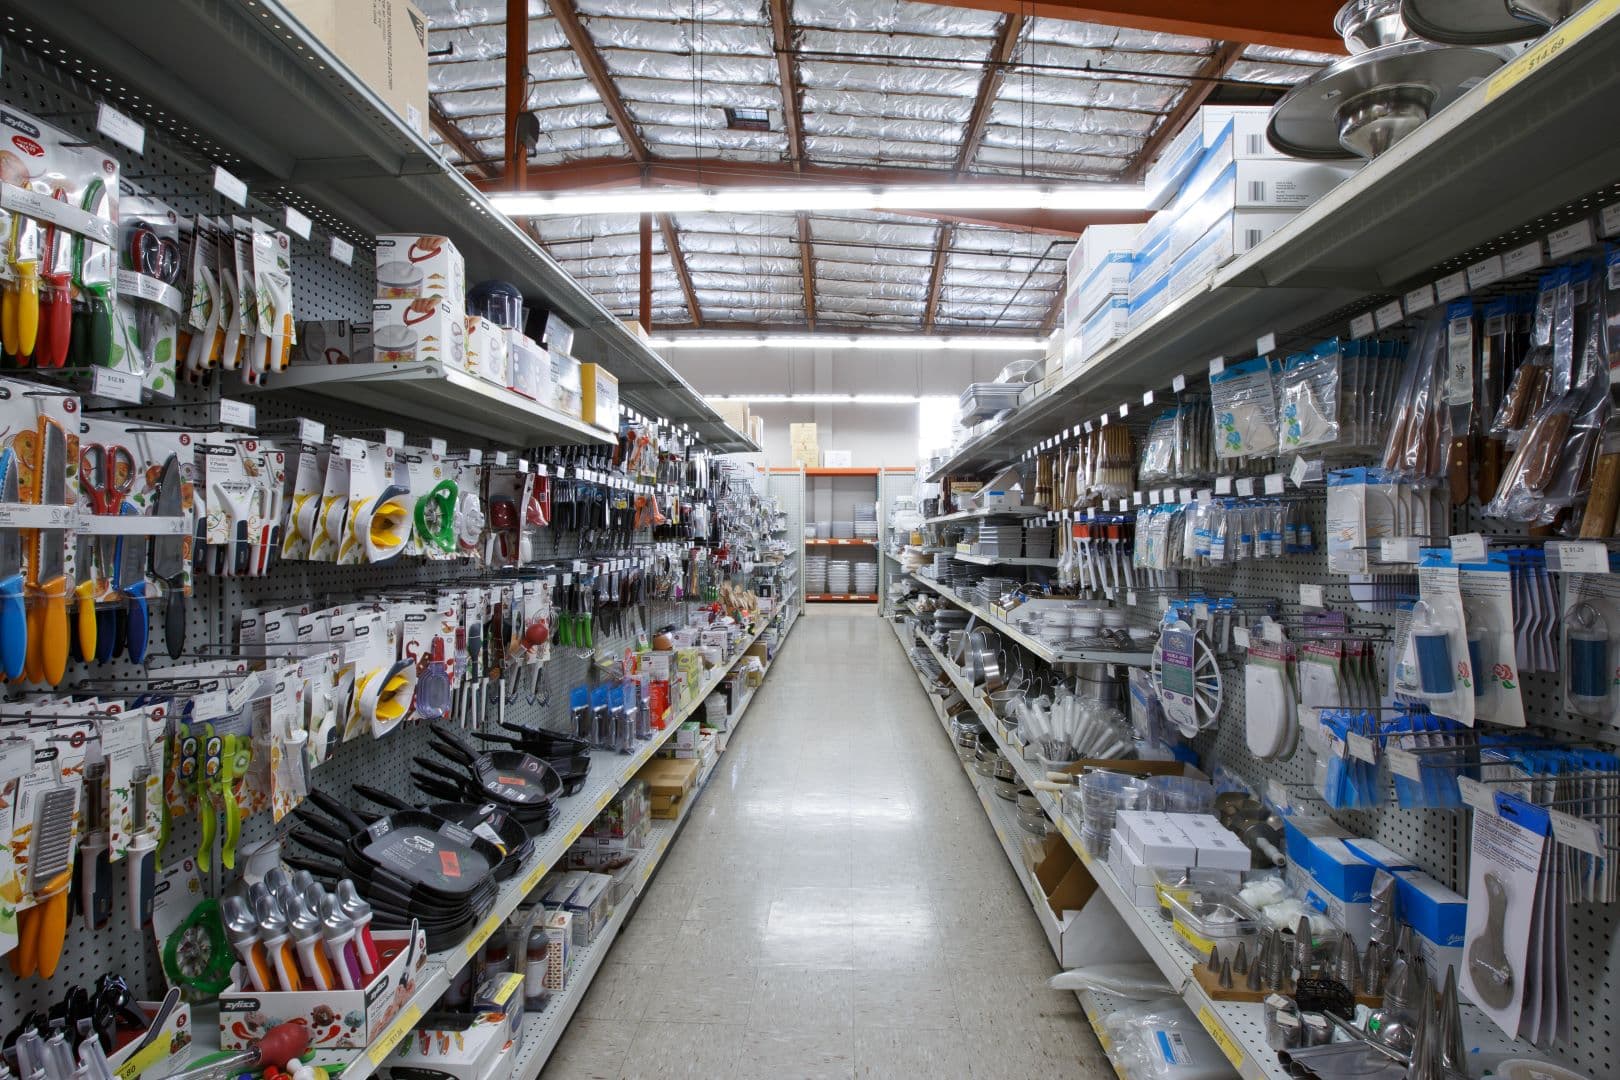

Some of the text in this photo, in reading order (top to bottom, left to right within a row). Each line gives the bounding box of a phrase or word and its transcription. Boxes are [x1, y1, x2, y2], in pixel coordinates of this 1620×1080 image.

[1528, 38, 1565, 70] $14.69
[66, 401, 72, 409] 5
[224, 1000, 256, 1010] zyliss
